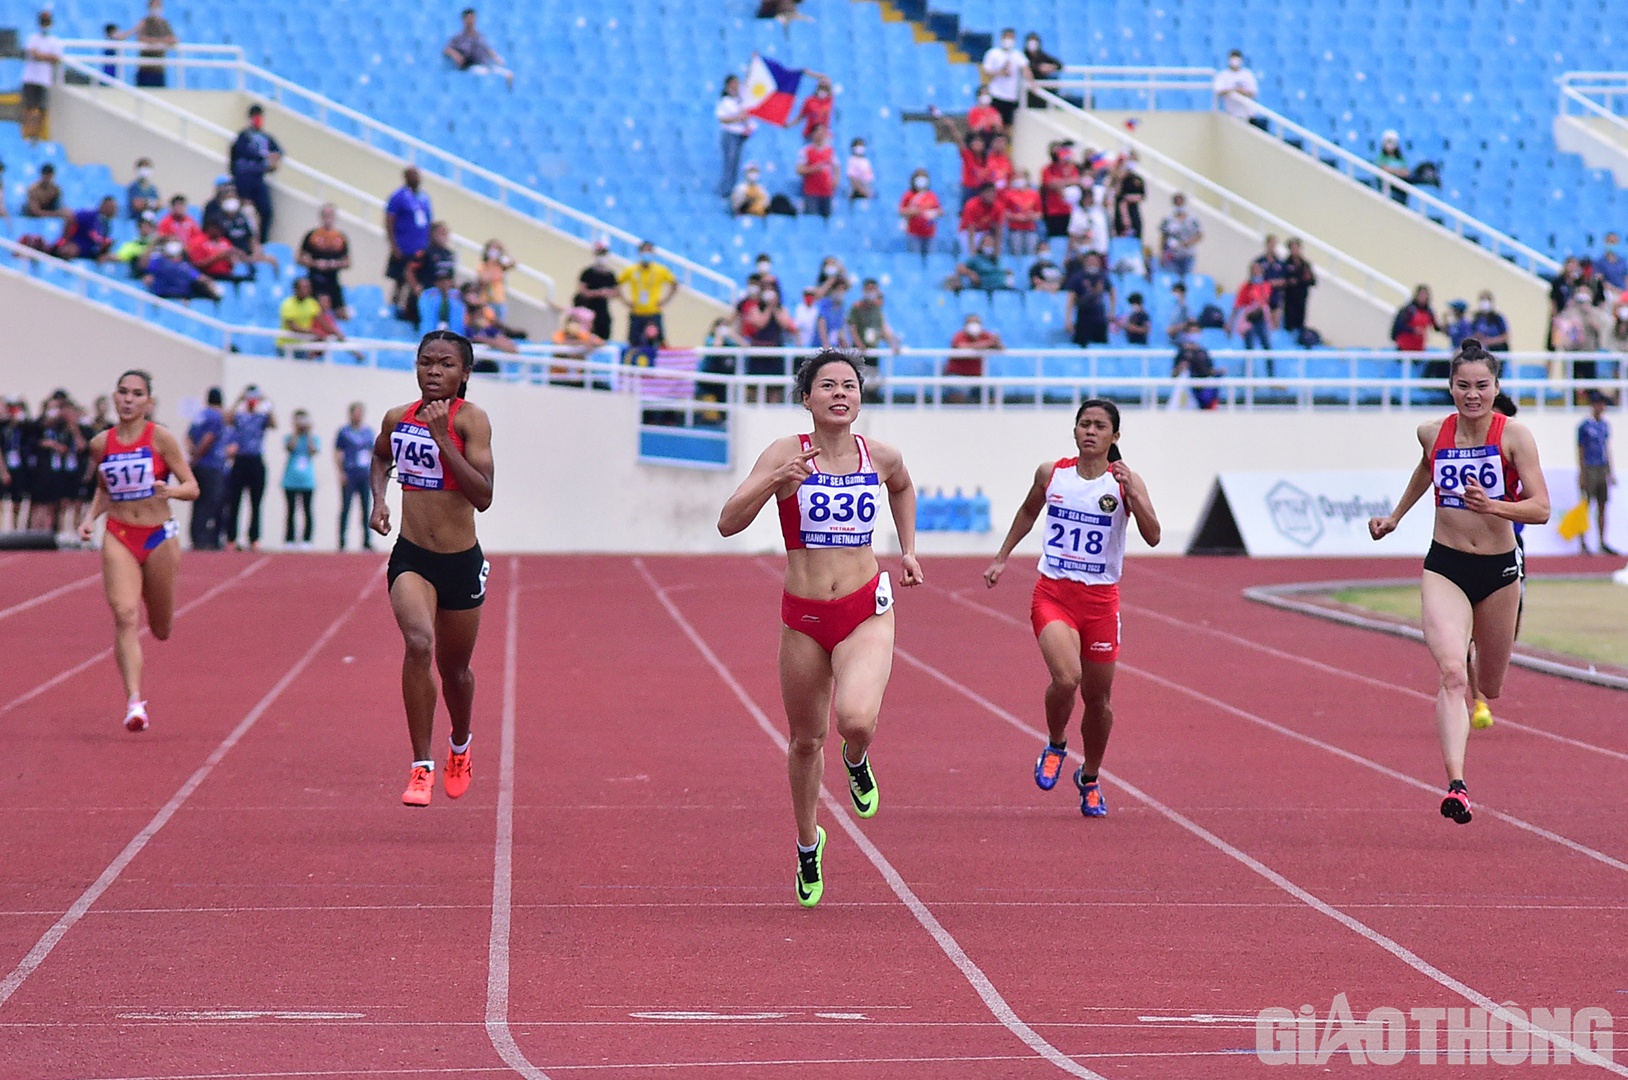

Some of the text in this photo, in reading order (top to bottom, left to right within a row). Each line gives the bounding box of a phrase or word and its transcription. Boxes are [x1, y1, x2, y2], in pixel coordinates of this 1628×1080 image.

[394, 438, 435, 469] 745
[105, 464, 145, 486] 517
[830, 476, 844, 486] SEA
[1440, 463, 1497, 490] 866
[809, 492, 875, 522] 836
[1068, 511, 1080, 520] SEA
[1081, 514, 1100, 524] Games
[806, 533, 826, 542] HANOI
[832, 534, 860, 544] VIETNAM
[1048, 523, 1103, 555] 218
